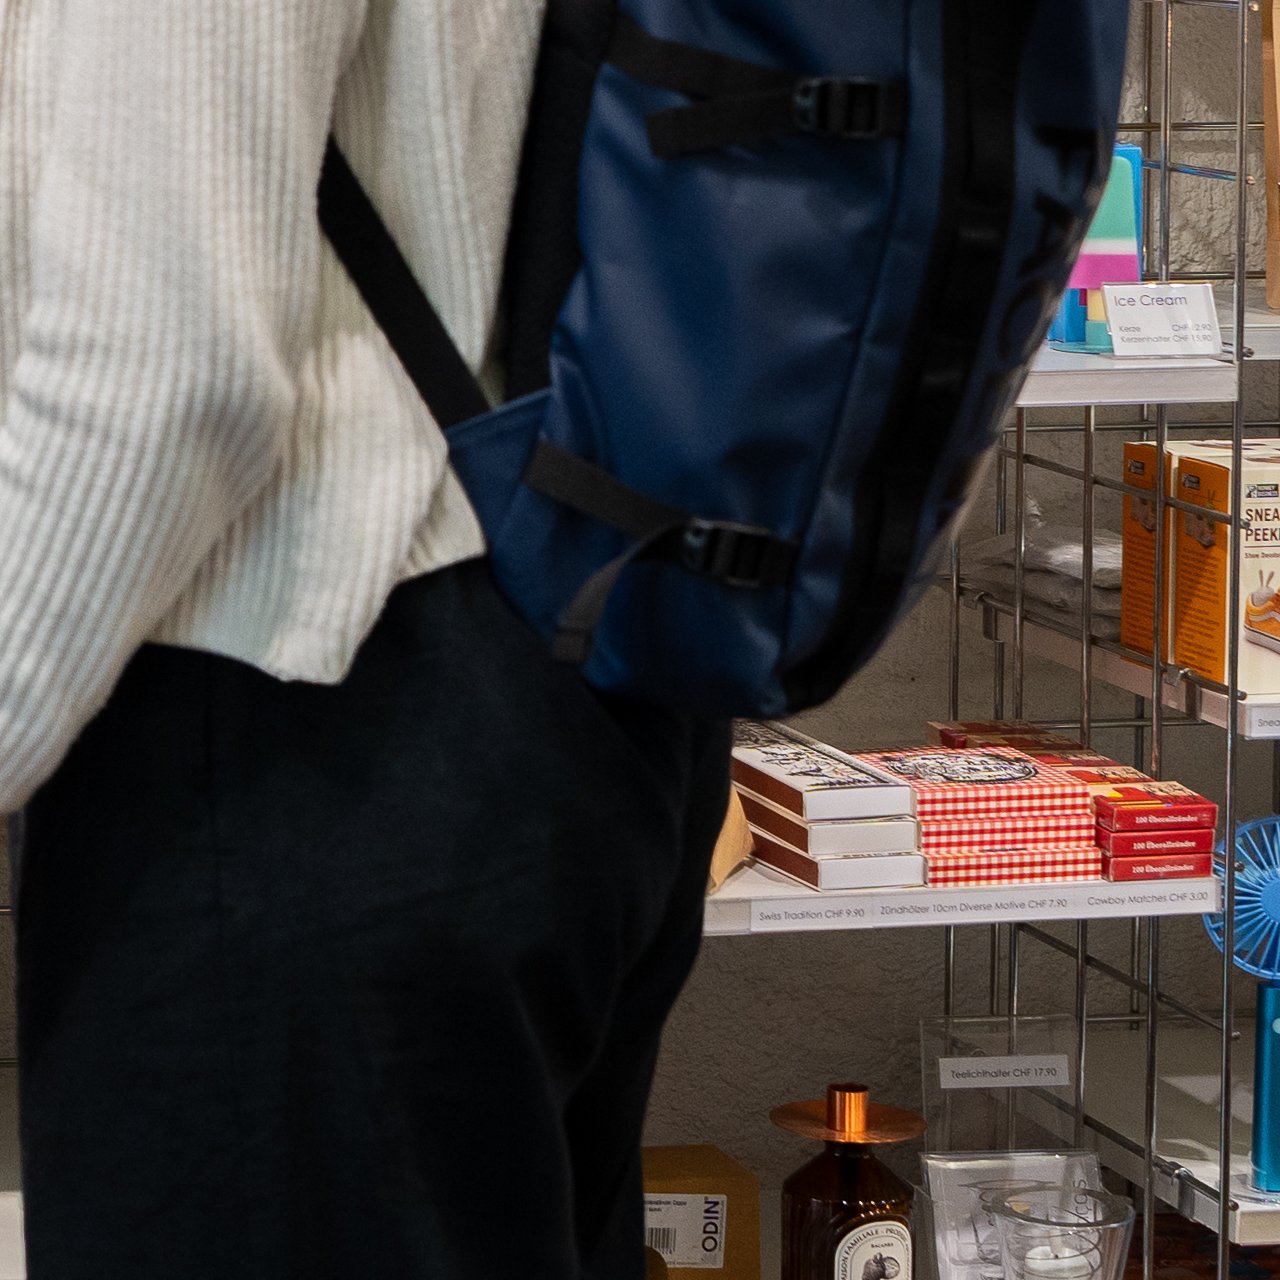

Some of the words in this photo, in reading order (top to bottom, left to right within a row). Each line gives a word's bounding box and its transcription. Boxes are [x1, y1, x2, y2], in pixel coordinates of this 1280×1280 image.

[1114, 295, 1135, 306] Ice
[1140, 295, 1187, 306] Cream
[1172, 324, 1188, 332] CHF
[1121, 335, 1170, 343] Kerzenhalter
[1172, 335, 1188, 343] CHF
[1087, 895, 1125, 906] Cowboy
[1128, 894, 1167, 904] Matches
[1169, 892, 1187, 901] CHF
[1189, 891, 1208, 901] 3.00
[880, 904, 930, 916] Zündhölzer
[932, 903, 957, 914] 10cm
[959, 901, 993, 912] Diverse
[994, 899, 1026, 911] Motive
[1028, 898, 1046, 909] CHF
[1048, 897, 1067, 908] 7.90
[759, 910, 781, 921] Swiss
[783, 909, 822, 920] Tradition
[824, 908, 844, 919] CHF
[846, 907, 865, 918] 9.90
[951, 1069, 1011, 1080] Teelichthalter
[1013, 1068, 1031, 1078] CHF
[1034, 1067, 1057, 1077] 17.90
[702, 1200, 720, 1252] ODIN
